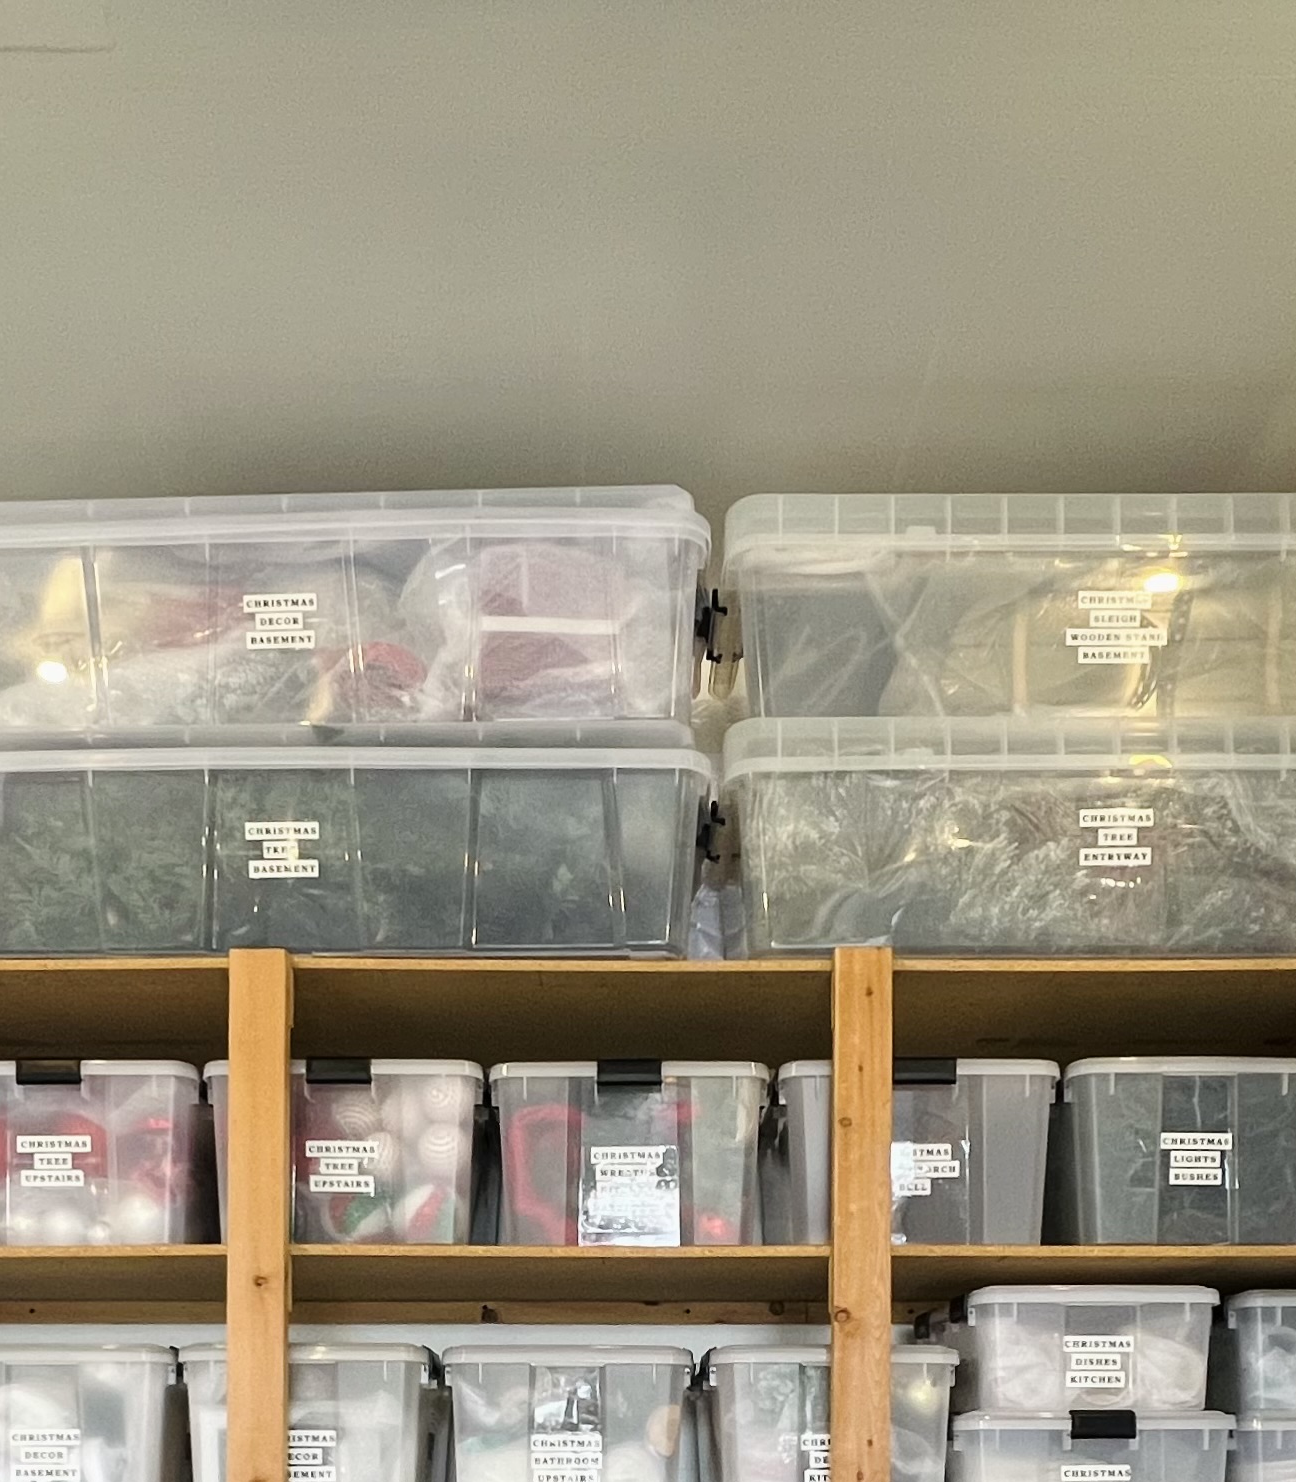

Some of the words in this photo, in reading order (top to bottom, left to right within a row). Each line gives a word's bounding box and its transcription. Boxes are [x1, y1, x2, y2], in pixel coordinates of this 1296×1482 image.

[246, 599, 315, 608] CHRISTMAS
[259, 617, 299, 626] DECOR
[1093, 614, 1137, 624] SLEIGH
[250, 635, 312, 645] BASEMENT
[1070, 633, 1120, 642] WOODEN
[1082, 651, 1144, 660] BASEMENT
[1082, 814, 1152, 823] CHRISTMAS
[248, 827, 317, 835] CHRISTMAS
[1103, 833, 1133, 842] TREE
[1083, 852, 1148, 861] ENTRYWAY
[253, 864, 316, 873] BASEMENT
[20, 1140, 88, 1149] CHRISTMAS
[1161, 1137, 1230, 1146] CHRISTMAS
[308, 1145, 376, 1154] CHRISTMAS
[593, 1151, 661, 1160] CHRISTMAS
[1173, 1155, 1217, 1163] LIGHTS
[38, 1157, 69, 1166] TREE
[324, 1162, 354, 1171] TREE
[25, 1174, 81, 1183] UPSTAIRS
[1174, 1173, 1219, 1181] BUSHES
[314, 1180, 370, 1188] UPSTAIRS
[1064, 1340, 1131, 1348] CHRISTMAS
[1075, 1358, 1118, 1366] DISHES
[1070, 1375, 1121, 1384] KITCHEN
[11, 1433, 80, 1442] CHRISTMAS
[532, 1439, 600, 1448] CHRISTMAS
[24, 1451, 64, 1460] DECOR
[534, 1457, 599, 1465] BATHROOM
[15, 1469, 76, 1477] BASEMENT
[1063, 1469, 1134, 1478] CHRISTMAS
[537, 1474, 594, 1482] UPSTAIRS
